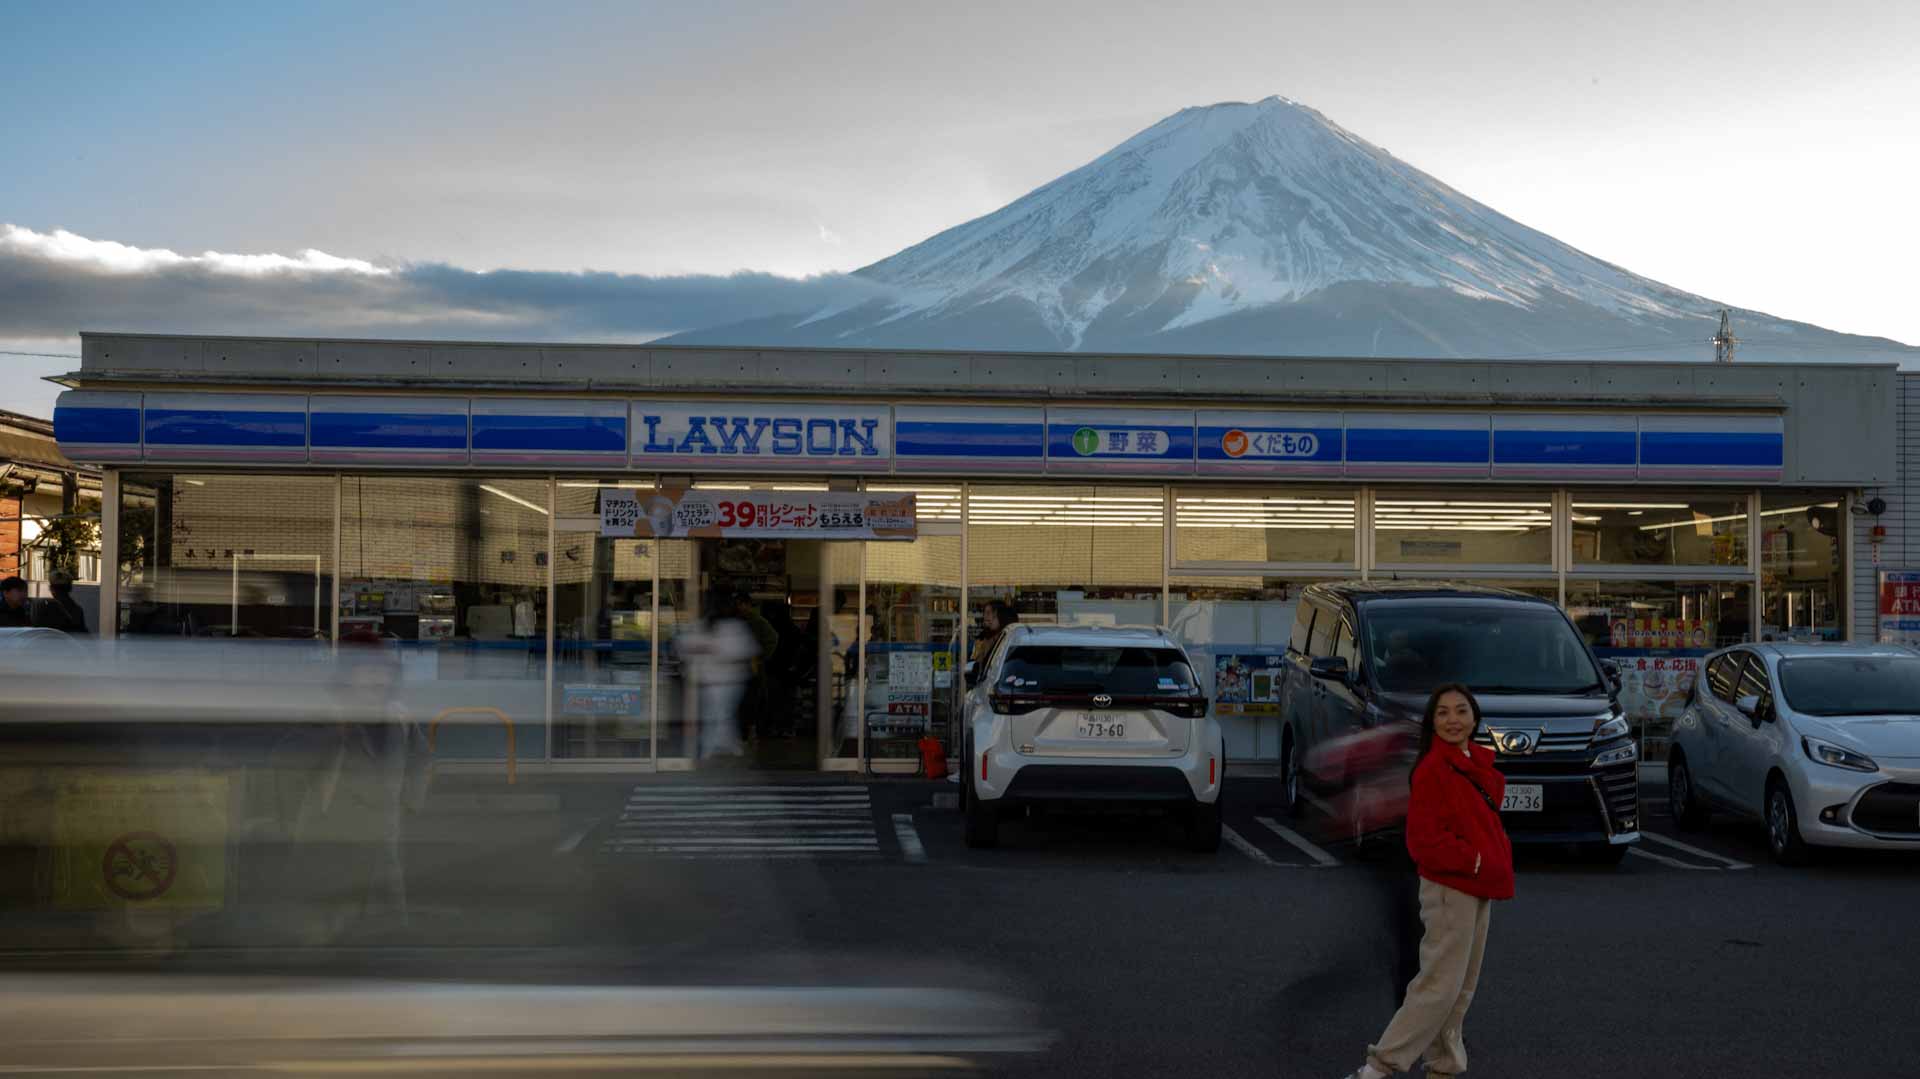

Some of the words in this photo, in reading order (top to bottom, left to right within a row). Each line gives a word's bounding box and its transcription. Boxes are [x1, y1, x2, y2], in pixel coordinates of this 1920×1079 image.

[643, 416, 878, 456] LAWSON
[1108, 431, 1158, 453] 野菜
[1252, 434, 1312, 455] くだもの
[718, 501, 756, 527] 39
[770, 503, 818, 515] レシート
[605, 518, 634, 527] を買うと
[770, 515, 818, 528] クーポン
[820, 513, 863, 525] もらえる
[1087, 723, 1124, 737] 73-60
